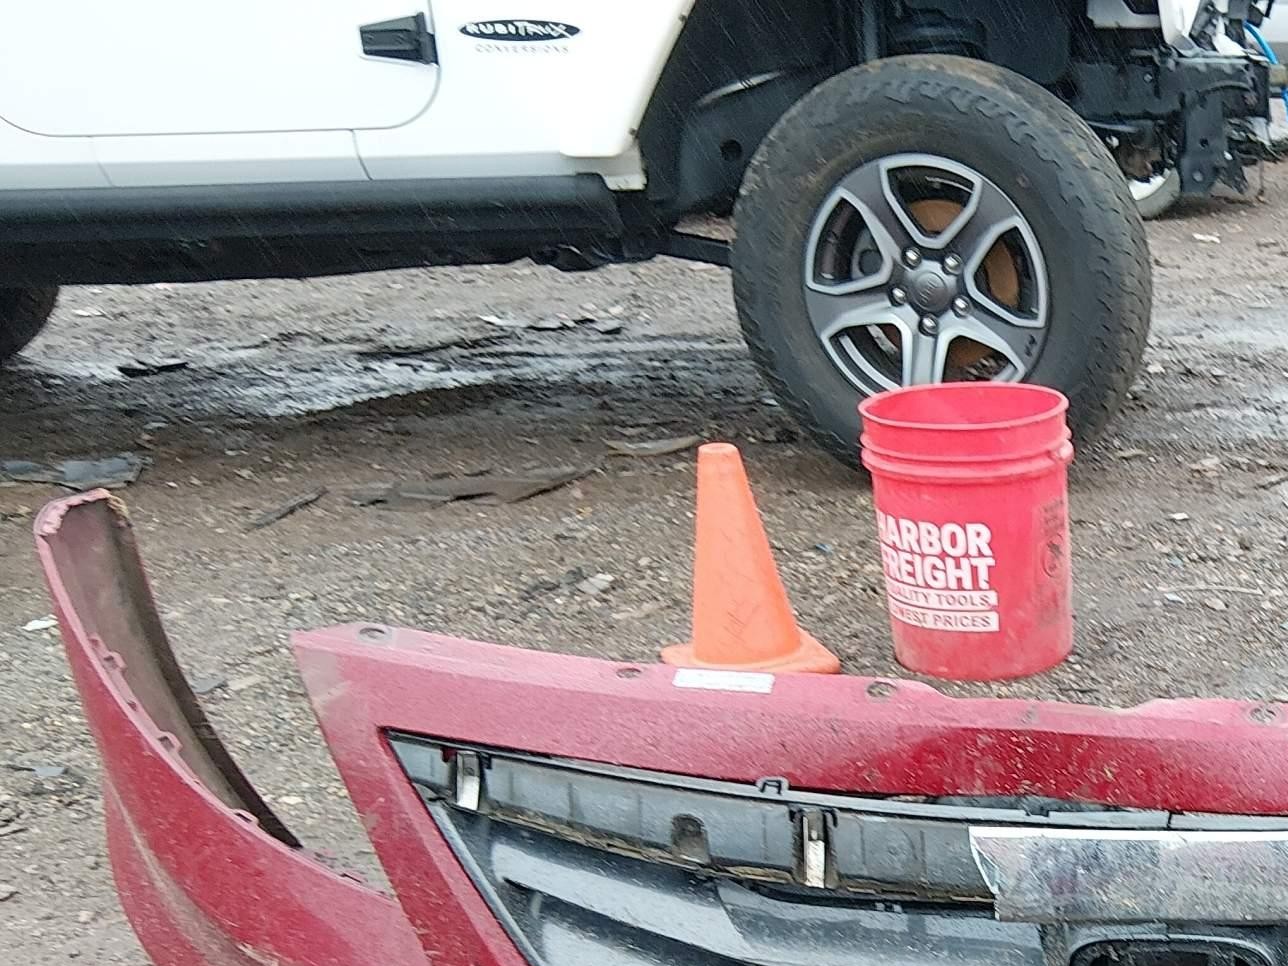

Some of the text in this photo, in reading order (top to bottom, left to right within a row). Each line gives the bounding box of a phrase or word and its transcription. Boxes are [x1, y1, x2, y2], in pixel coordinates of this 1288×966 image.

[887, 578, 992, 607] LITY TOOLS
[890, 601, 992, 628] WEST PRICES
